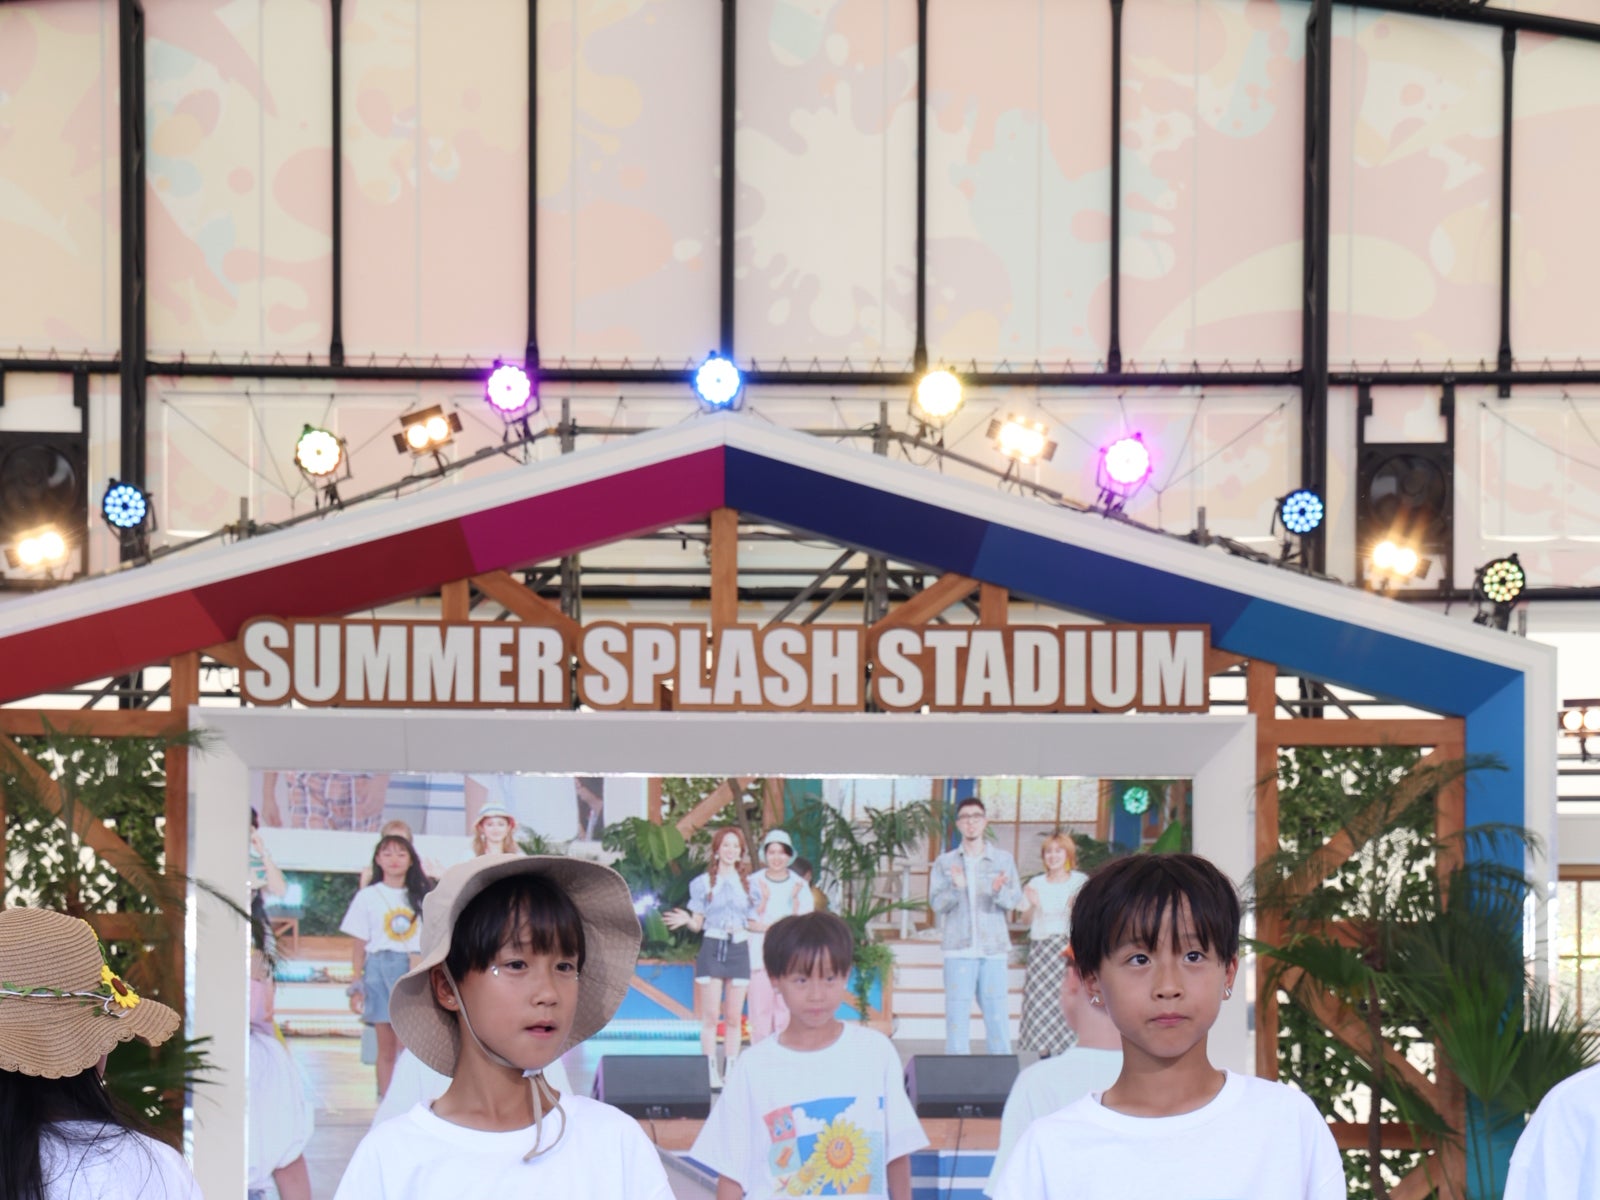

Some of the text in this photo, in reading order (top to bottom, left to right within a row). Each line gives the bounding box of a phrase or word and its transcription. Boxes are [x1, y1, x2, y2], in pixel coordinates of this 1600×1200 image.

[244, 621, 1204, 707] SUMMER SPLASH STADIUM
